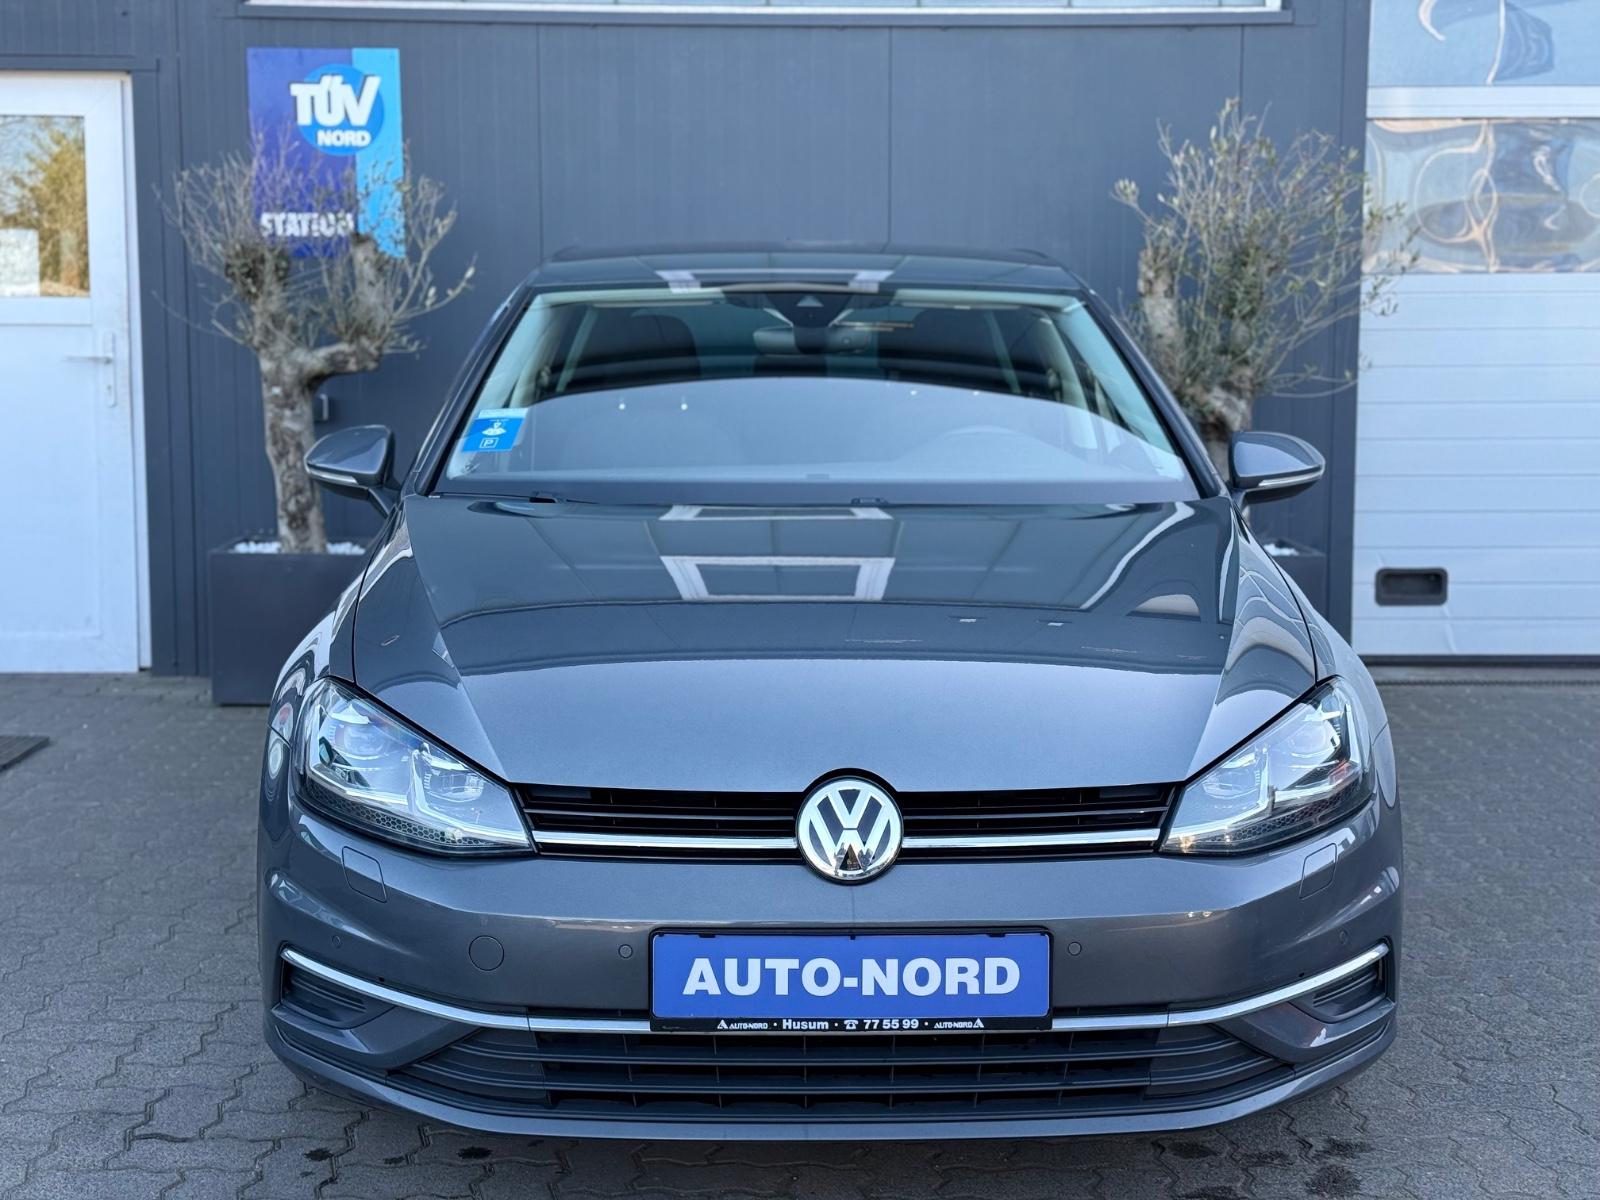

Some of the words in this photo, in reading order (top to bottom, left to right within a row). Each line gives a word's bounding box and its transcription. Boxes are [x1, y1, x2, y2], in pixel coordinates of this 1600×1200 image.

[289, 74, 382, 127] TÜV
[316, 130, 372, 147] NORD
[802, 782, 898, 878] VW
[682, 957, 1021, 997] AUTO-NORD
[728, 1022, 769, 1030] AUTO-NORD
[782, 1018, 829, 1030] Husum
[863, 1019, 880, 1030] 77
[882, 1019, 900, 1030] 55
[902, 1018, 919, 1029] 99
[933, 1021, 973, 1029] AUTO-NORD
